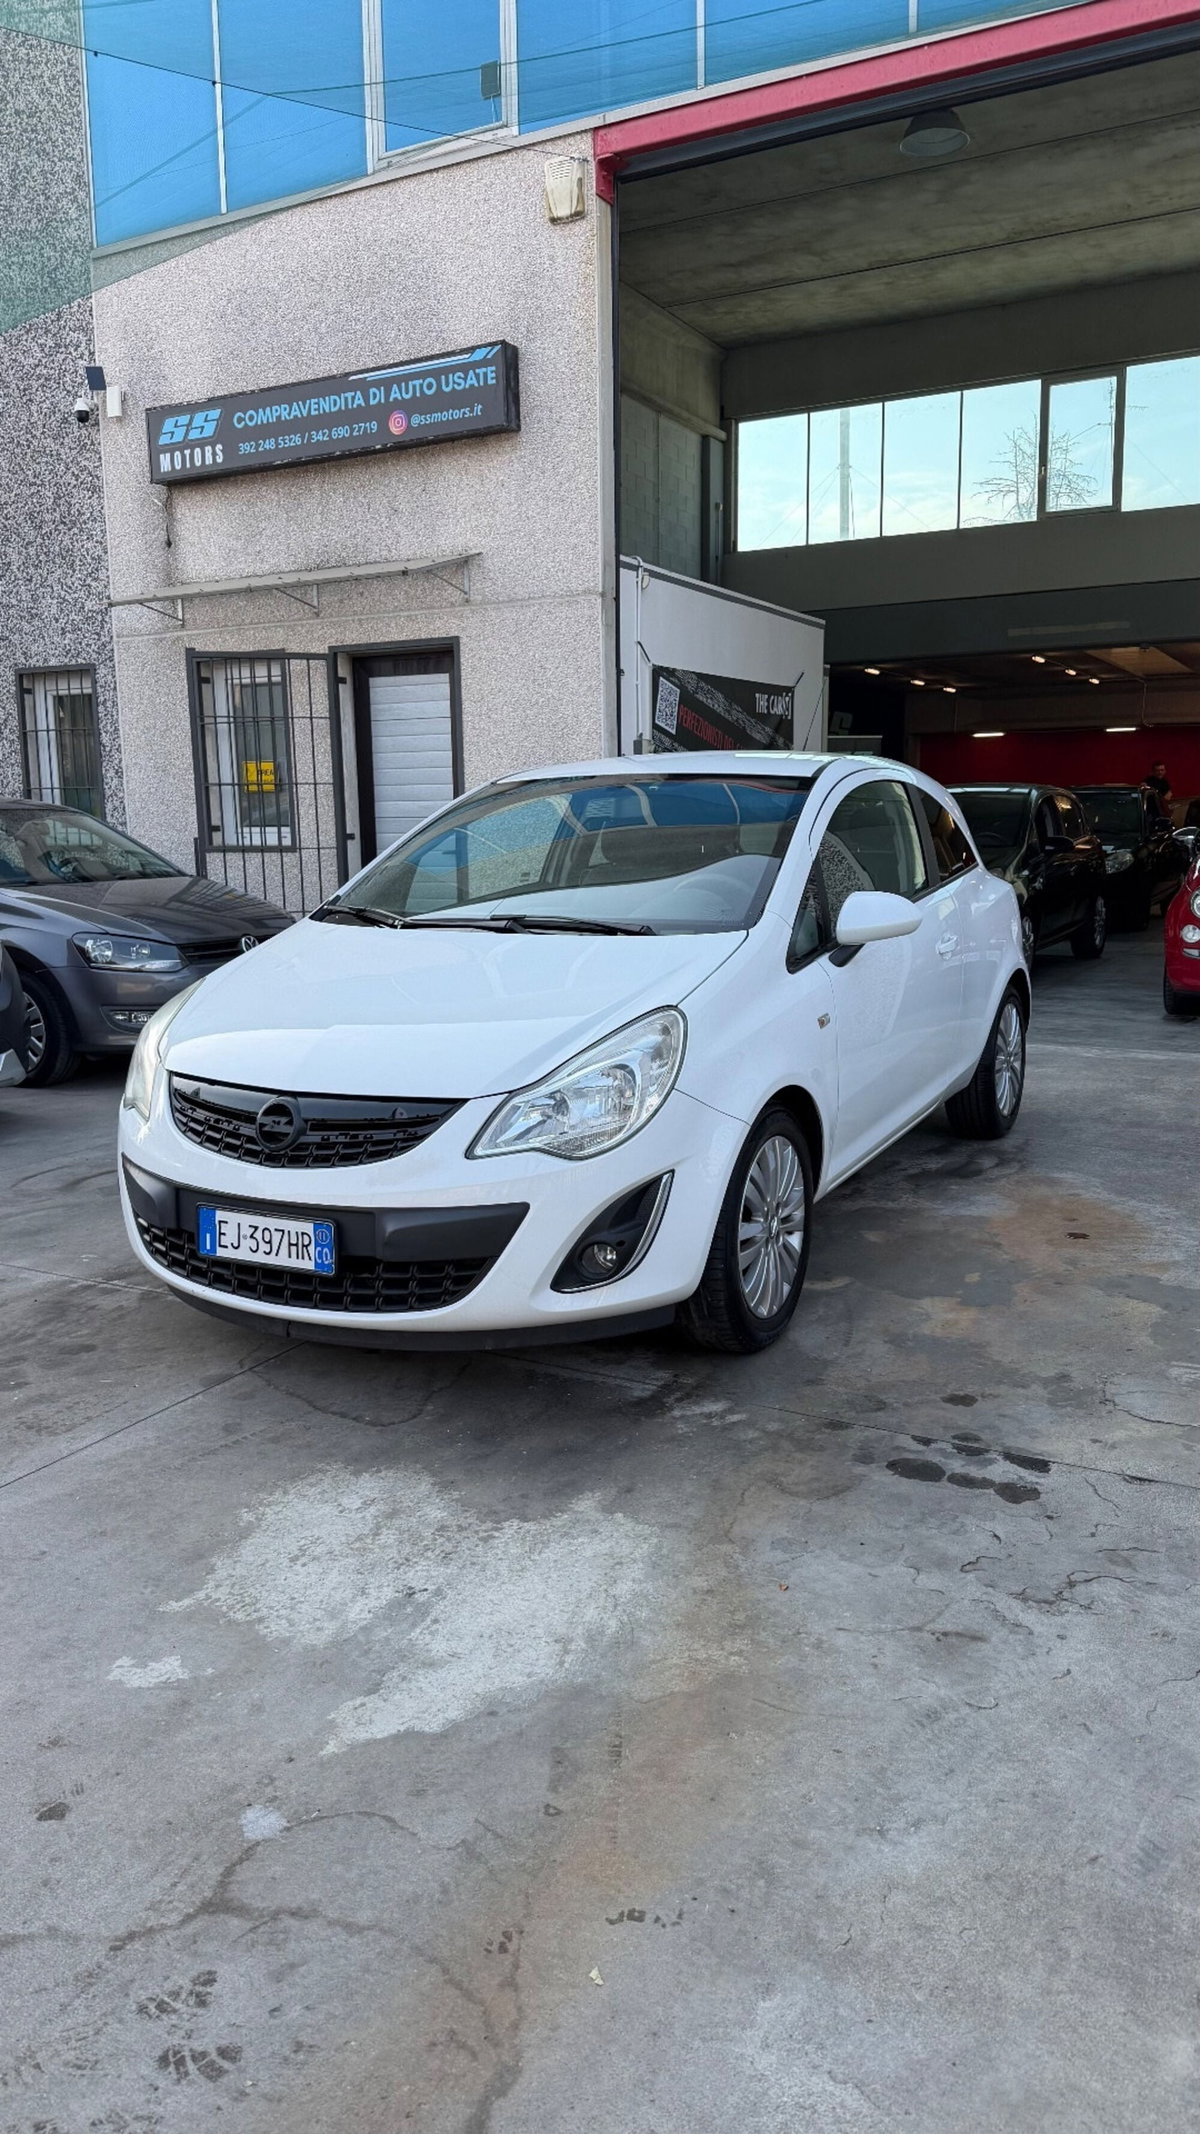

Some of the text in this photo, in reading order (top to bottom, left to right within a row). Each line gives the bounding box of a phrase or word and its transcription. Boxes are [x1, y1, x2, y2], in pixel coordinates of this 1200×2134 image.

[233, 366, 496, 428] COMPRAVENDITA DI AUTO USATE
[159, 409, 221, 445] SS
[410, 403, 482, 427] @ssmotors.it
[238, 441, 256, 454] 392
[258, 438, 276, 451] 248
[278, 433, 302, 448] 5326
[310, 429, 329, 443] 342
[331, 425, 350, 439] 690
[352, 420, 378, 436] 2719
[160, 444, 223, 472] MOTORS
[755, 692, 768, 714] THE
